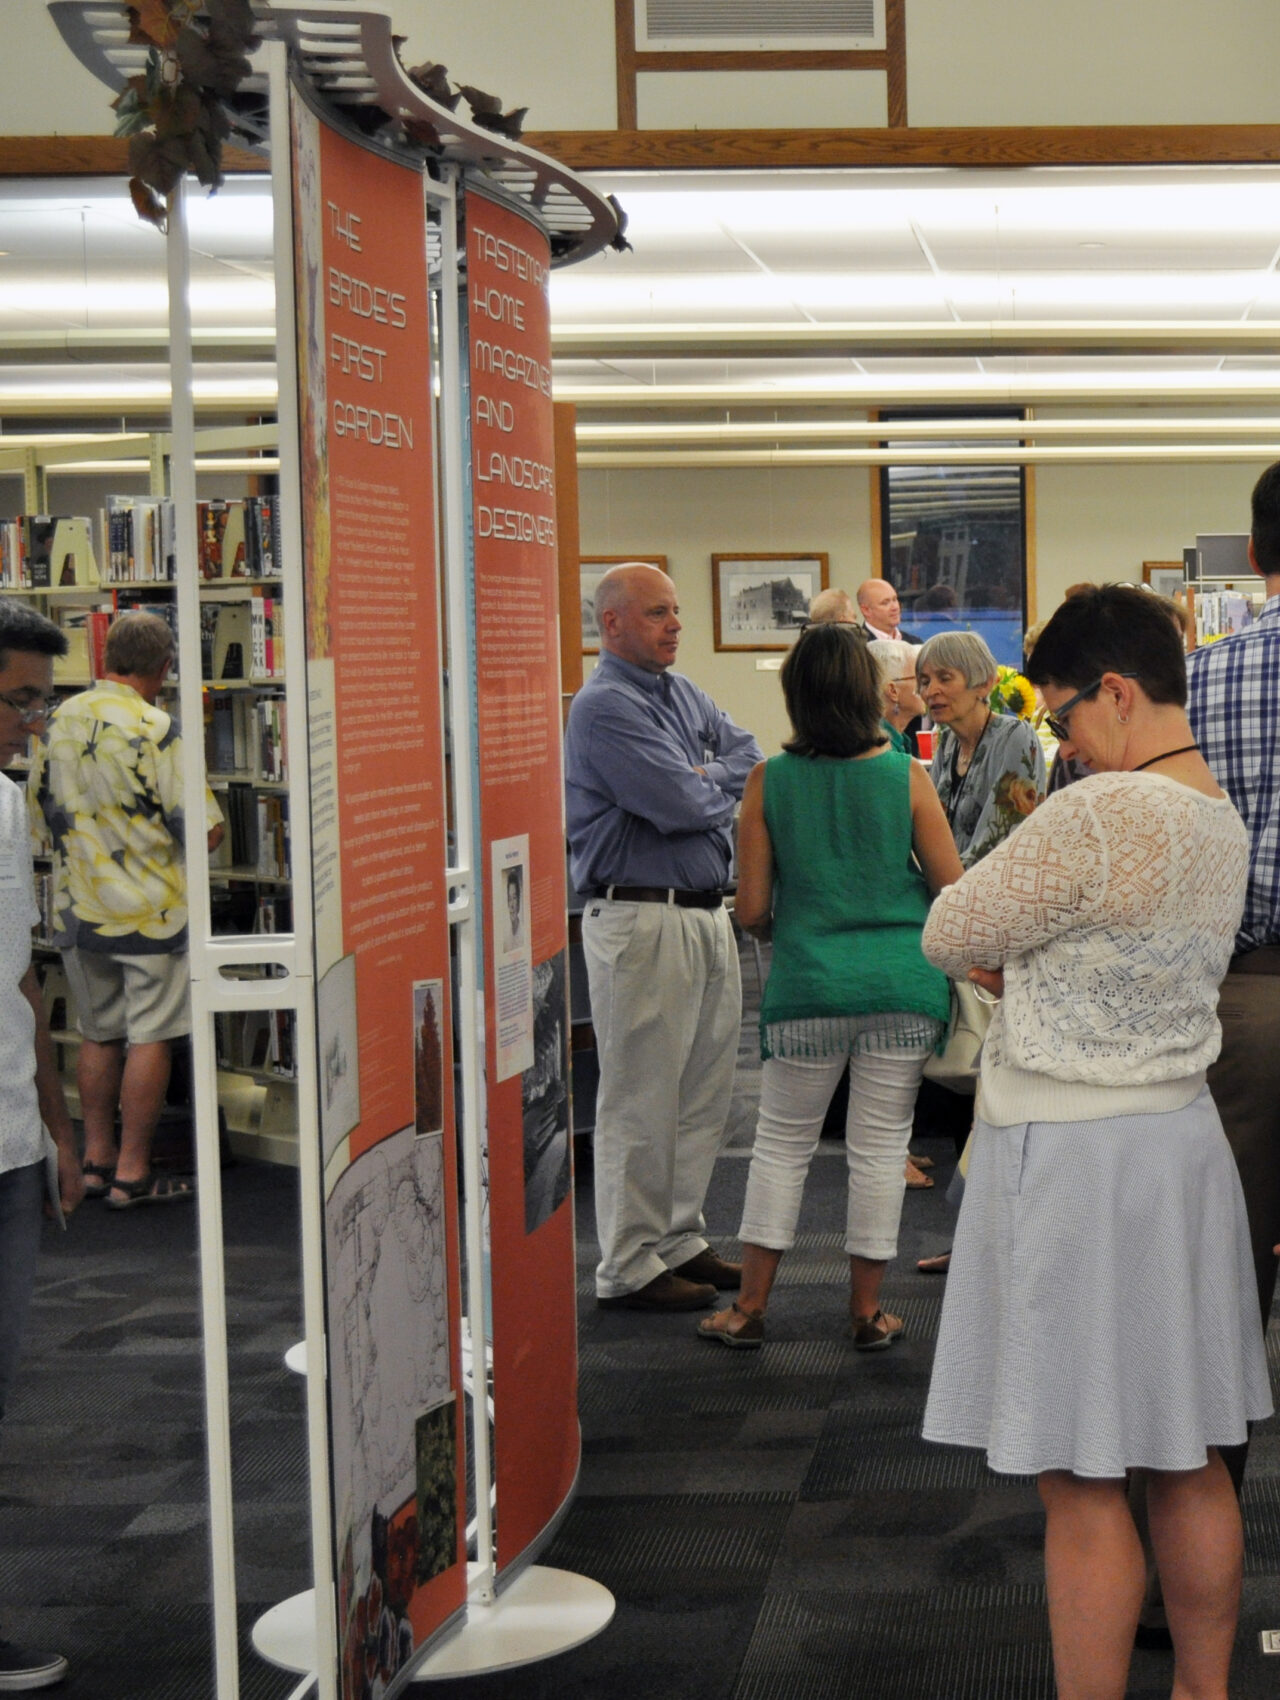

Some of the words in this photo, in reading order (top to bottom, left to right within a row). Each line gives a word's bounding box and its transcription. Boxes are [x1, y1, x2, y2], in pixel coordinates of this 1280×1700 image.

[327, 200, 362, 252] THE
[328, 267, 407, 328] BRIDE'S
[473, 283, 525, 332] HOME
[331, 333, 387, 384] FIRST
[333, 399, 414, 450] GARDEN
[476, 395, 514, 433] AND
[477, 450, 553, 497] LANDSCAPE
[478, 505, 554, 547] DESIGNERS
